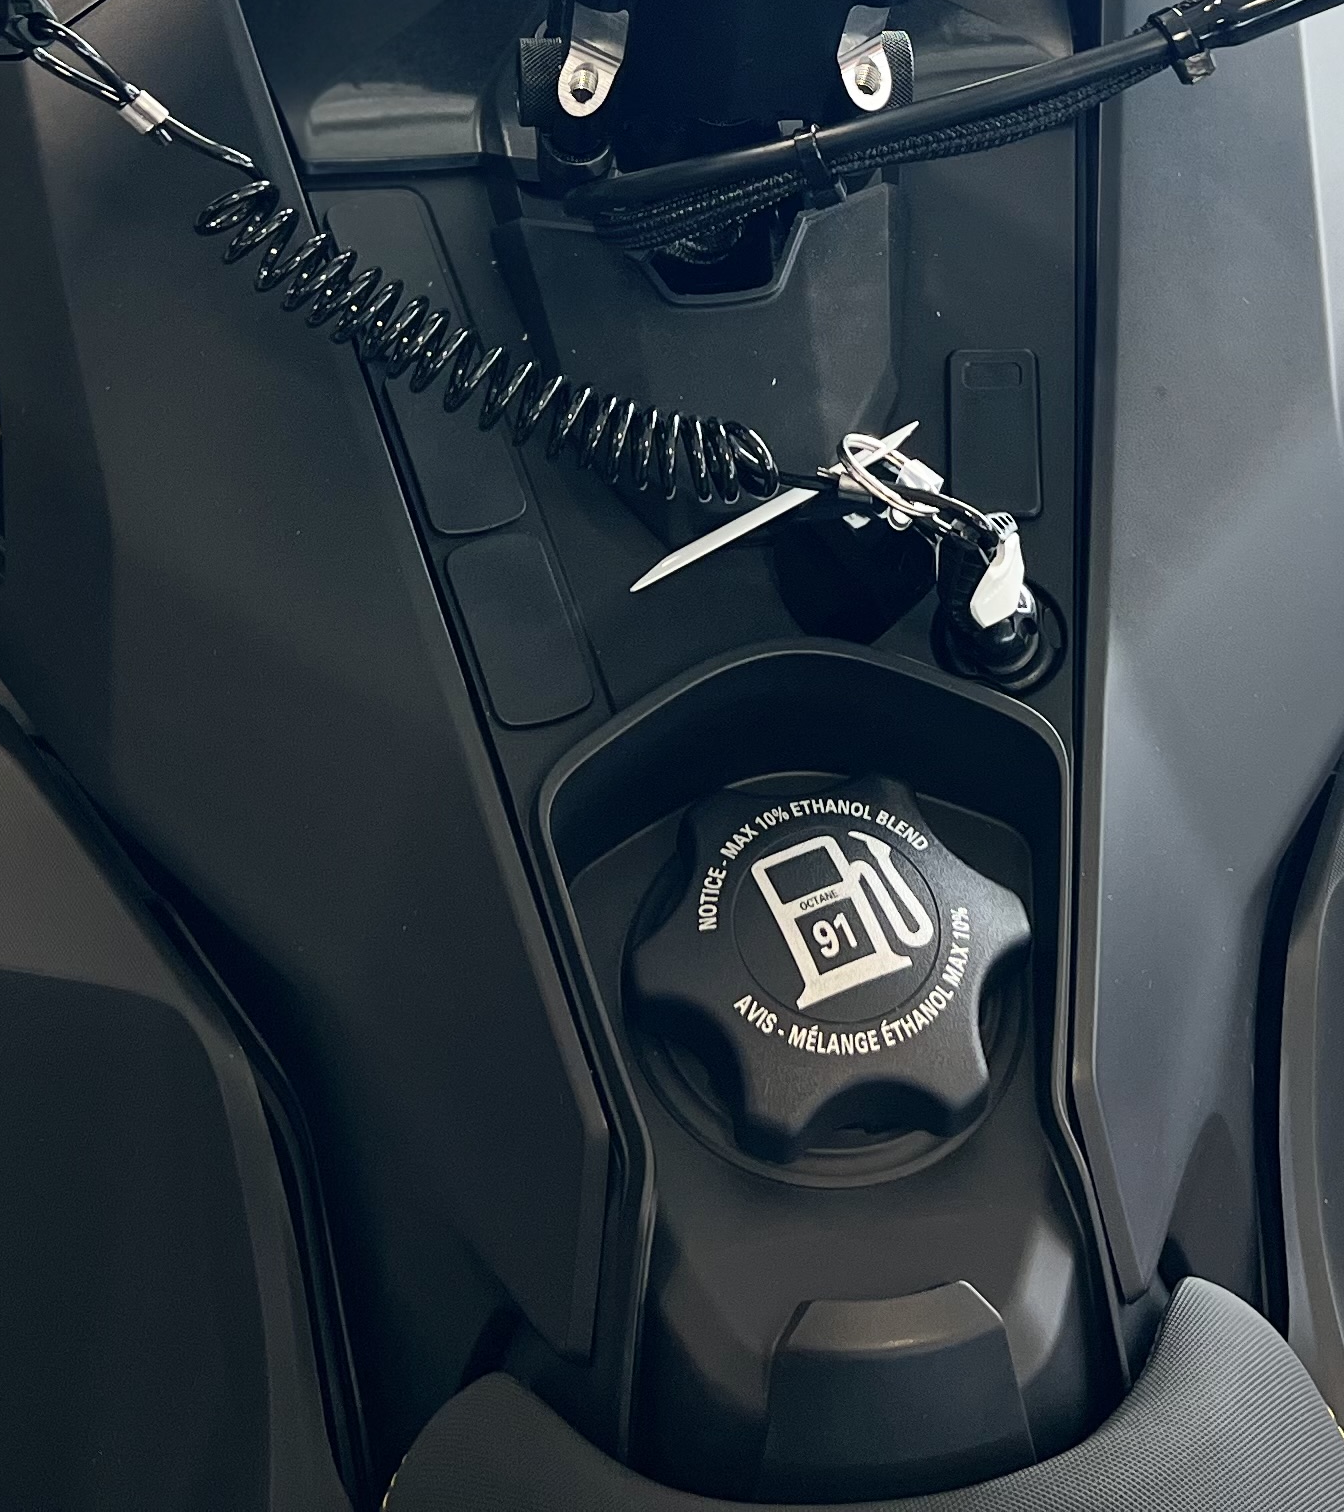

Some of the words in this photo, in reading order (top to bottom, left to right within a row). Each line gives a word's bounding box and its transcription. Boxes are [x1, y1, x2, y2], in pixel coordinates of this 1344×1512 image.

[698, 865, 727, 932] NOTICE
[720, 828, 759, 861] MAX
[754, 805, 790, 833] 10%
[789, 798, 872, 821] ETHANOL
[875, 809, 929, 852] BLEND
[799, 889, 839, 911] OCTANE
[811, 912, 858, 958] 91
[949, 906, 971, 940] 10%
[941, 944, 971, 987] MAX
[733, 993, 776, 1034] AVIS
[881, 984, 954, 1047] ÉTHANOL
[788, 1025, 881, 1055] MÉLANGE
